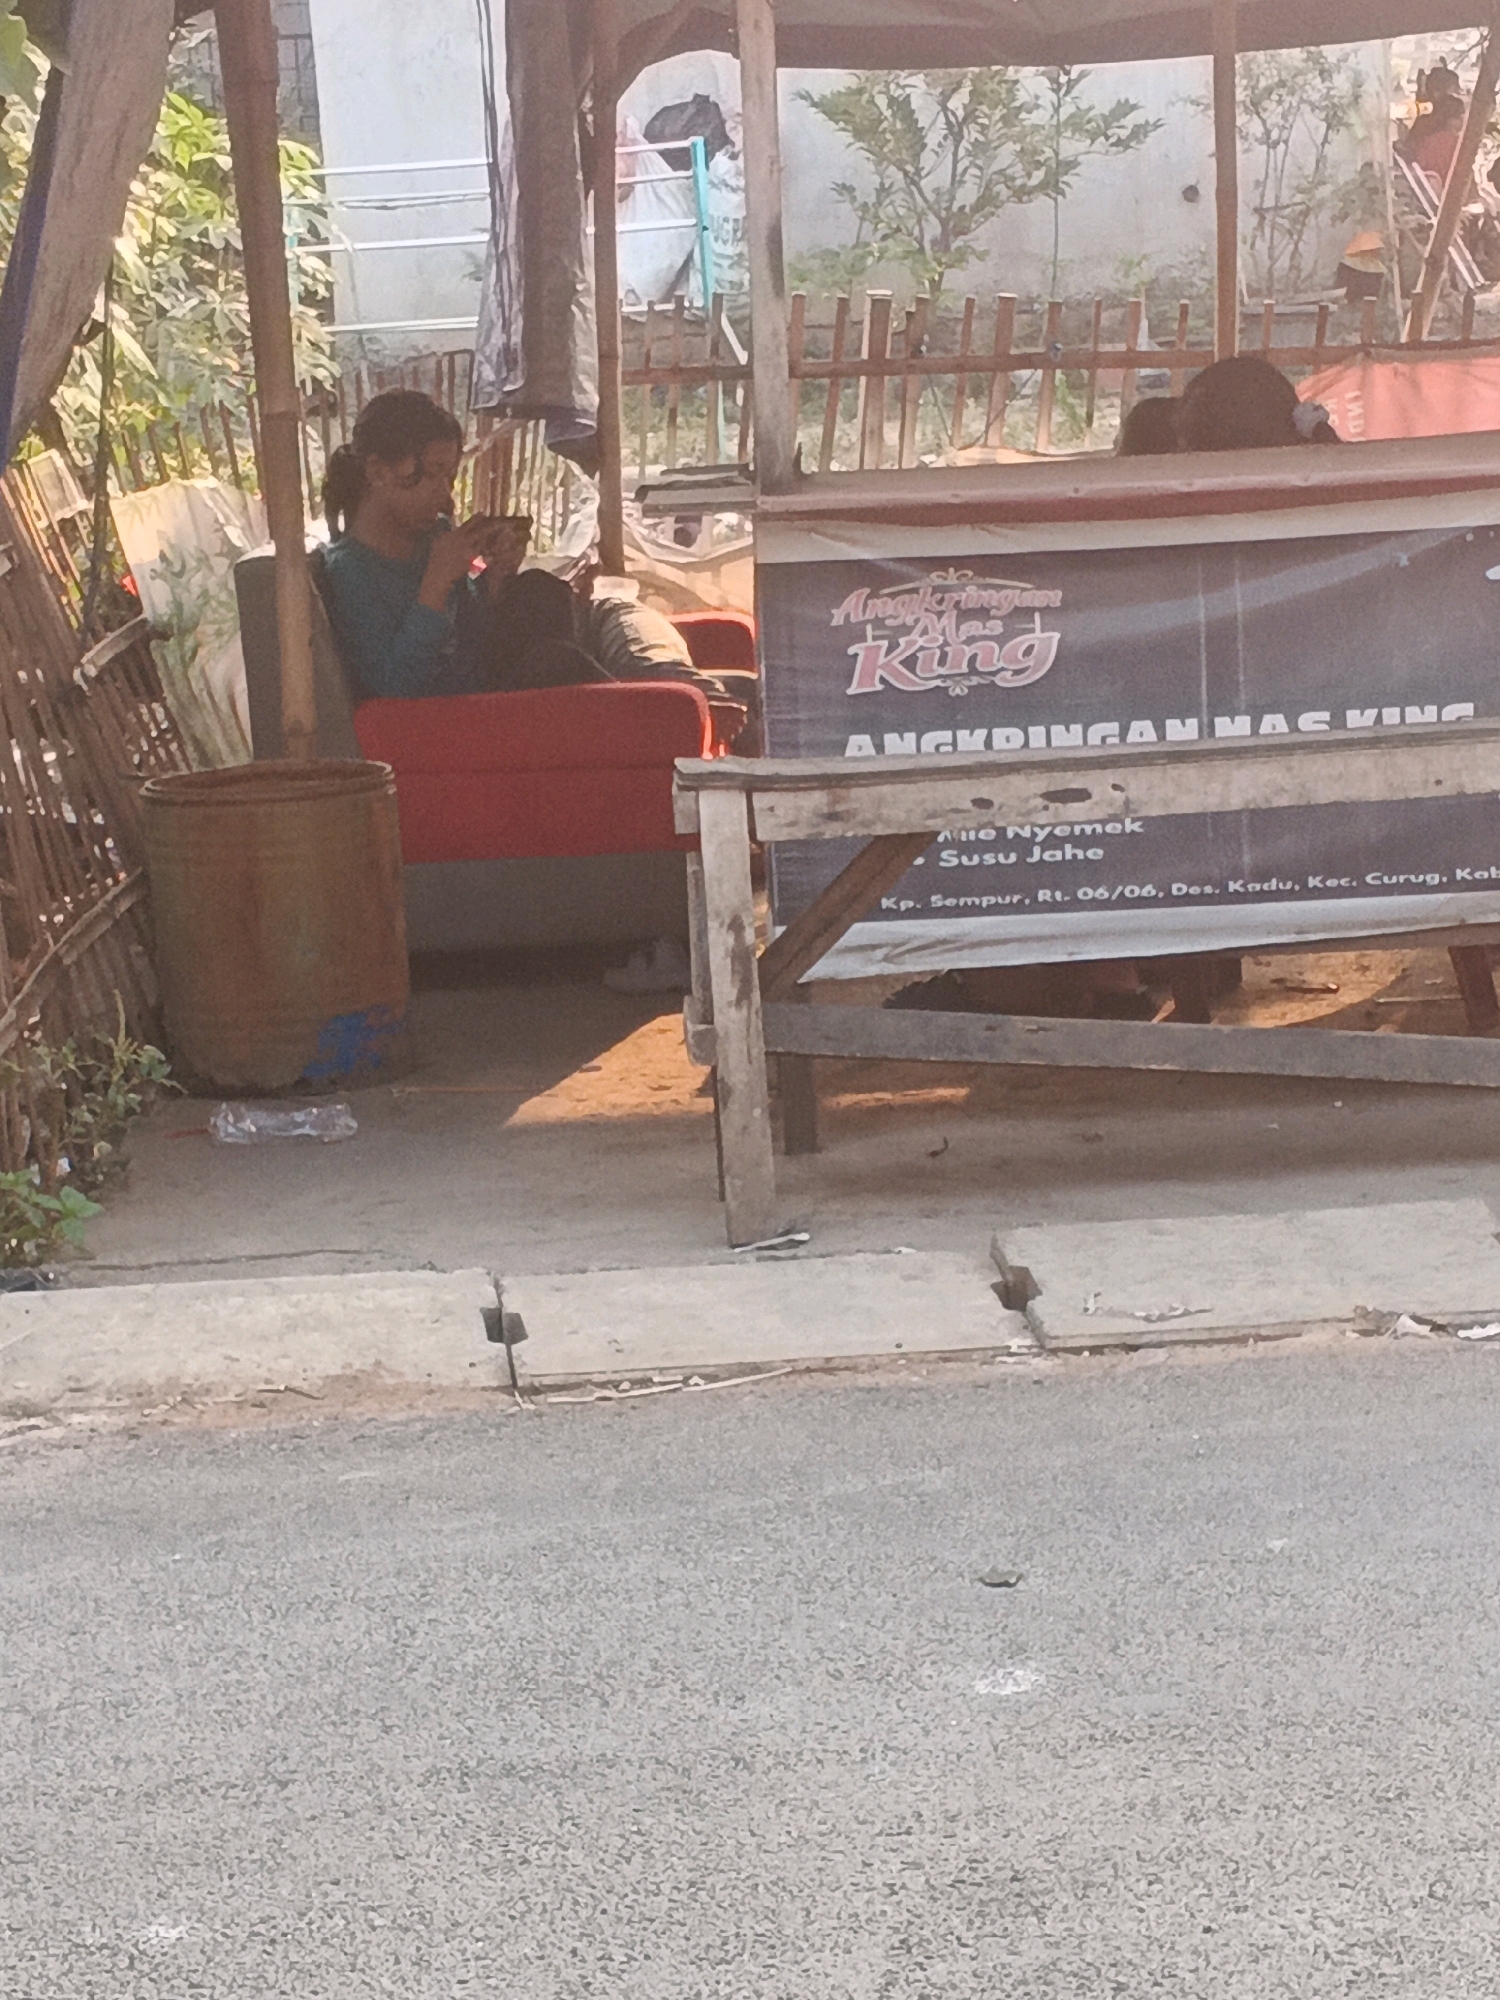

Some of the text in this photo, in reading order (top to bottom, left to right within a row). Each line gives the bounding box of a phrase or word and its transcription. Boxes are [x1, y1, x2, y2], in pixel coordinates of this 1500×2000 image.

[830, 586, 1063, 627] Angkringan
[909, 609, 1004, 646] Mas
[846, 632, 1062, 695] King
[1006, 817, 1145, 842] Nyemek
[939, 843, 1104, 868] Susu Jahe
[881, 896, 922, 912] Kp.
[930, 893, 1030, 911] Sempur,
[1170, 881, 1220, 897] Des.
[1307, 875, 1357, 889] Kec.
